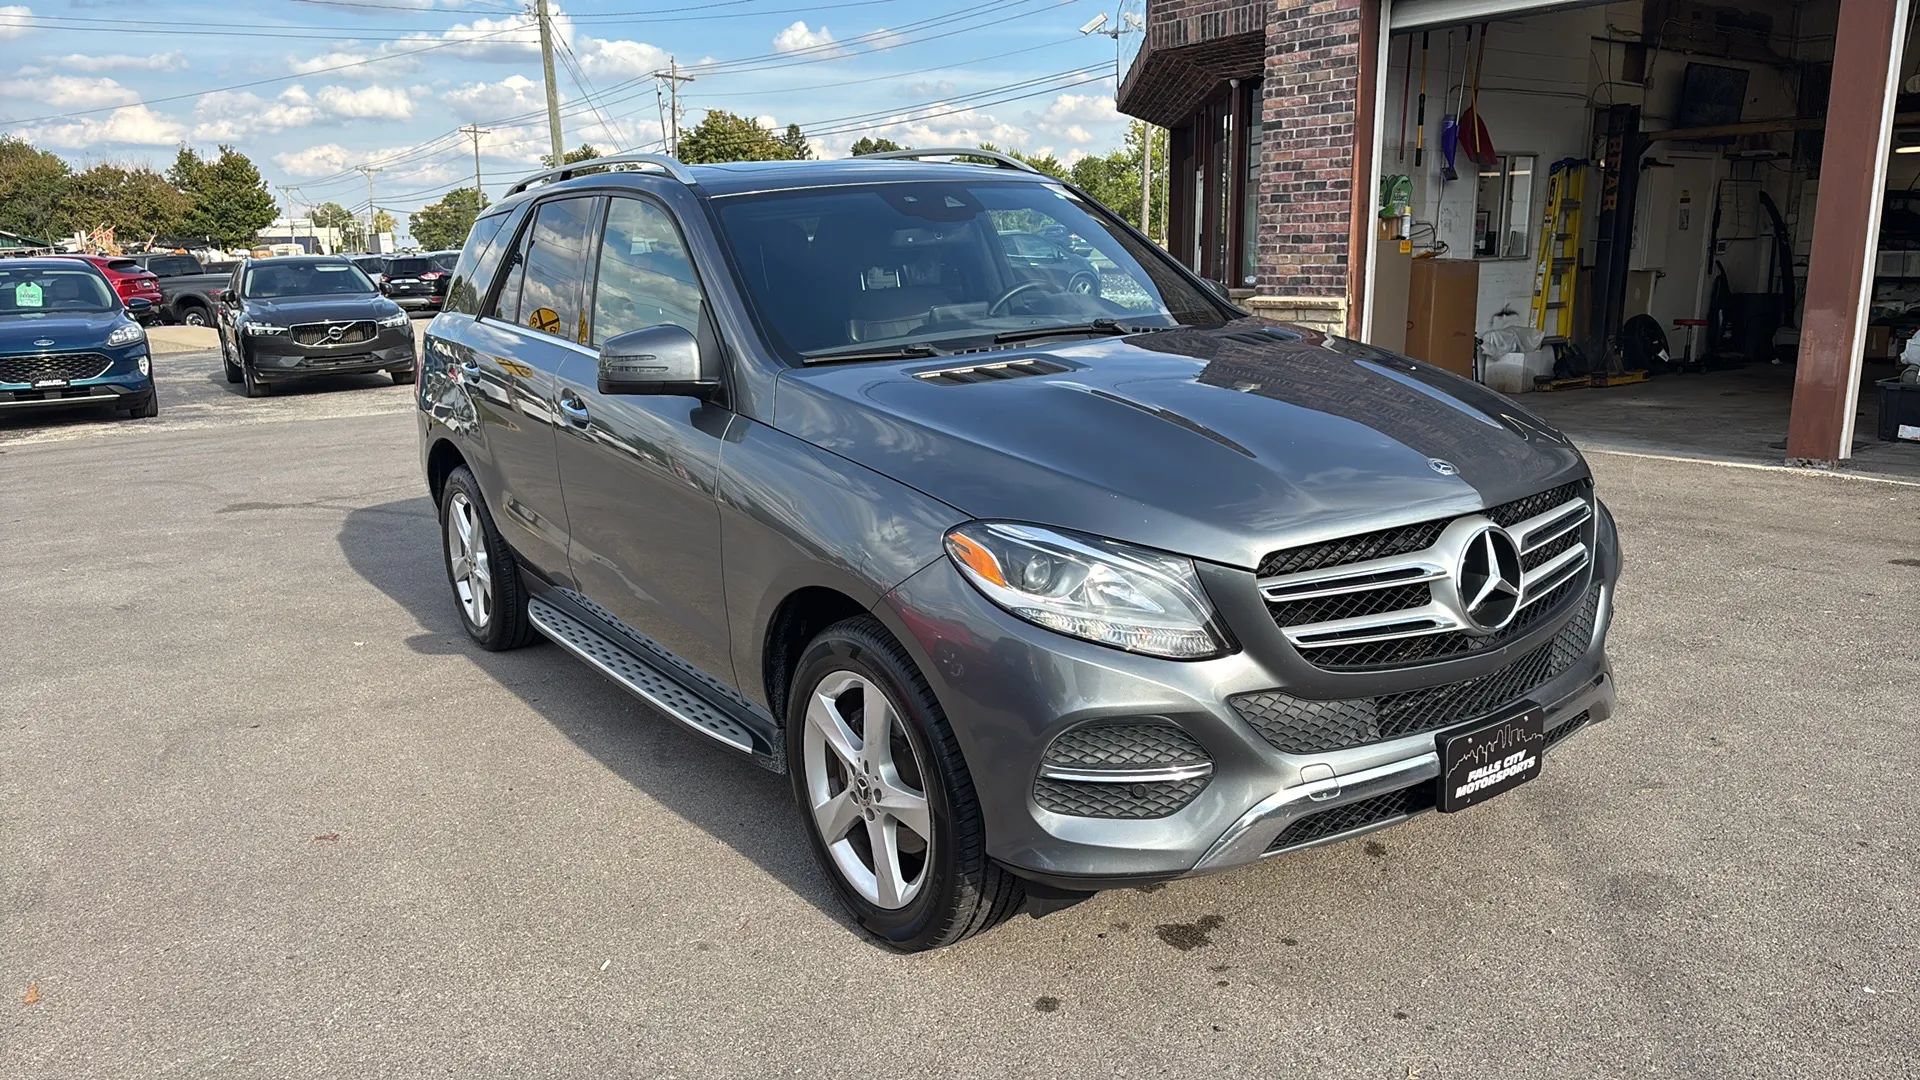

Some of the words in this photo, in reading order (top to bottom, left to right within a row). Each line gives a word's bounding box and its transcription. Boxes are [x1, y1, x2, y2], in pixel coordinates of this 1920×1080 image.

[1602, 135, 1623, 212] BEAR
[1455, 756, 1536, 799] MOTORSPORTS
[1467, 760, 1502, 783] FALLS
[1503, 749, 1527, 768] CITY
